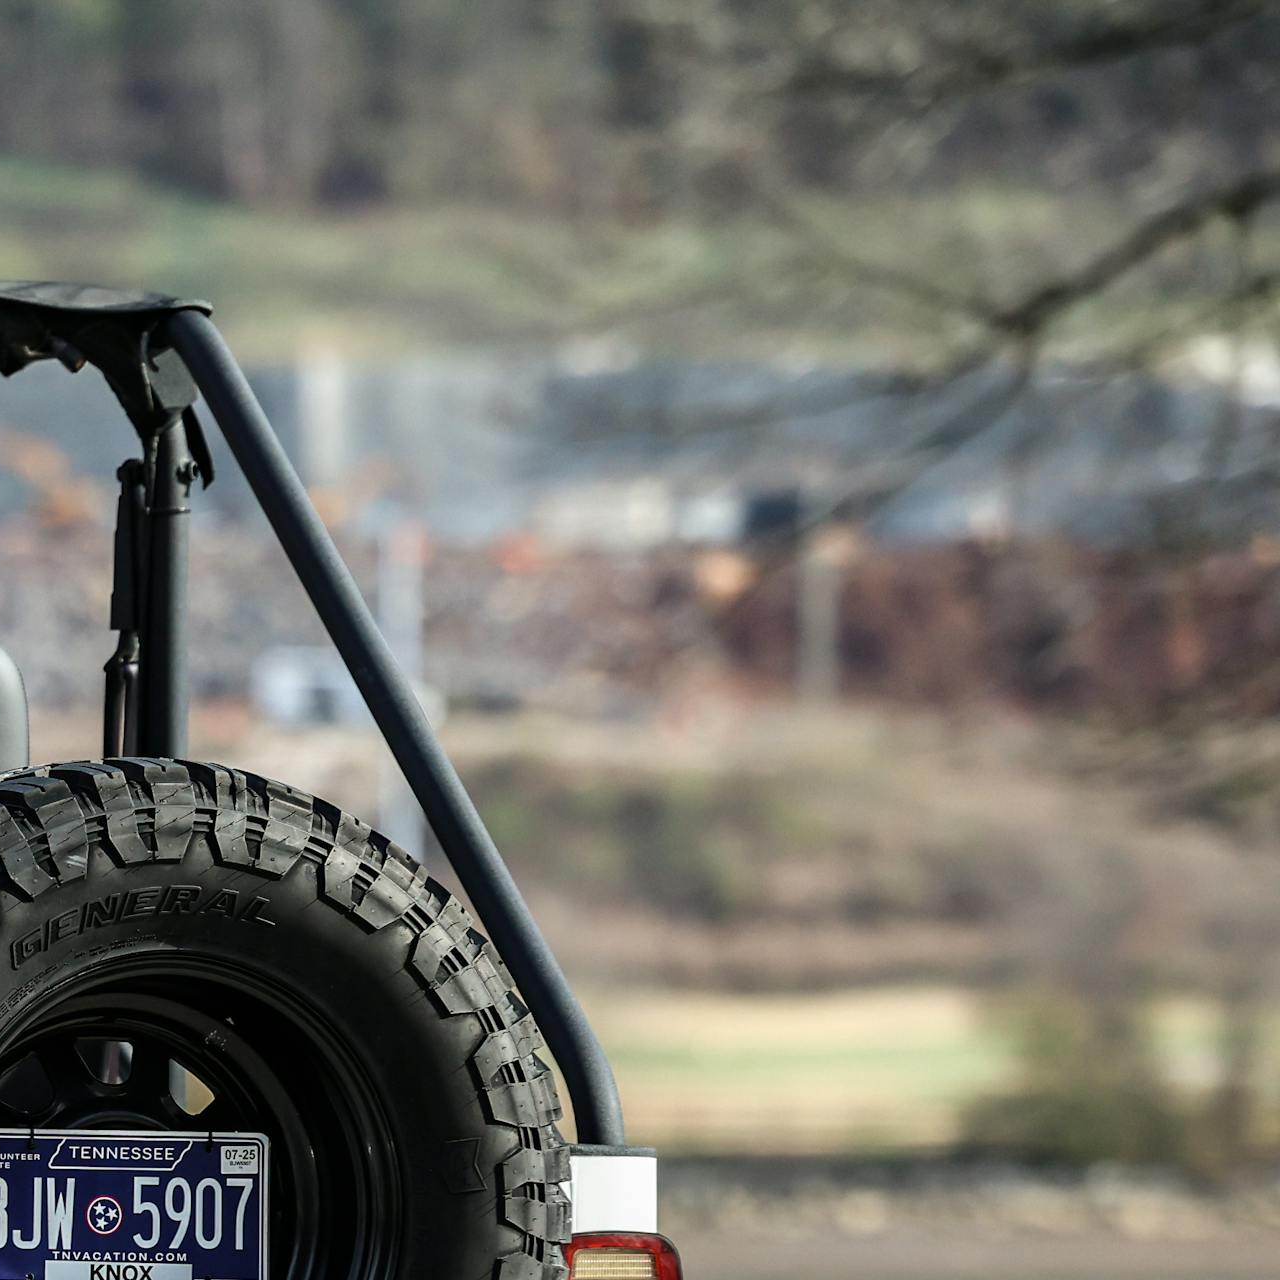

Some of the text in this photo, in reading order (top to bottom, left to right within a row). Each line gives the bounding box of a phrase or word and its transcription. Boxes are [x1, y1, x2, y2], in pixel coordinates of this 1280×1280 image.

[10, 885, 277, 970] GENERAL
[69, 1146, 175, 1161] TENNESSEE
[225, 1149, 256, 1160] 07-25
[132, 1176, 254, 1250] 5907
[52, 1251, 188, 1262] TNVACATION.COM
